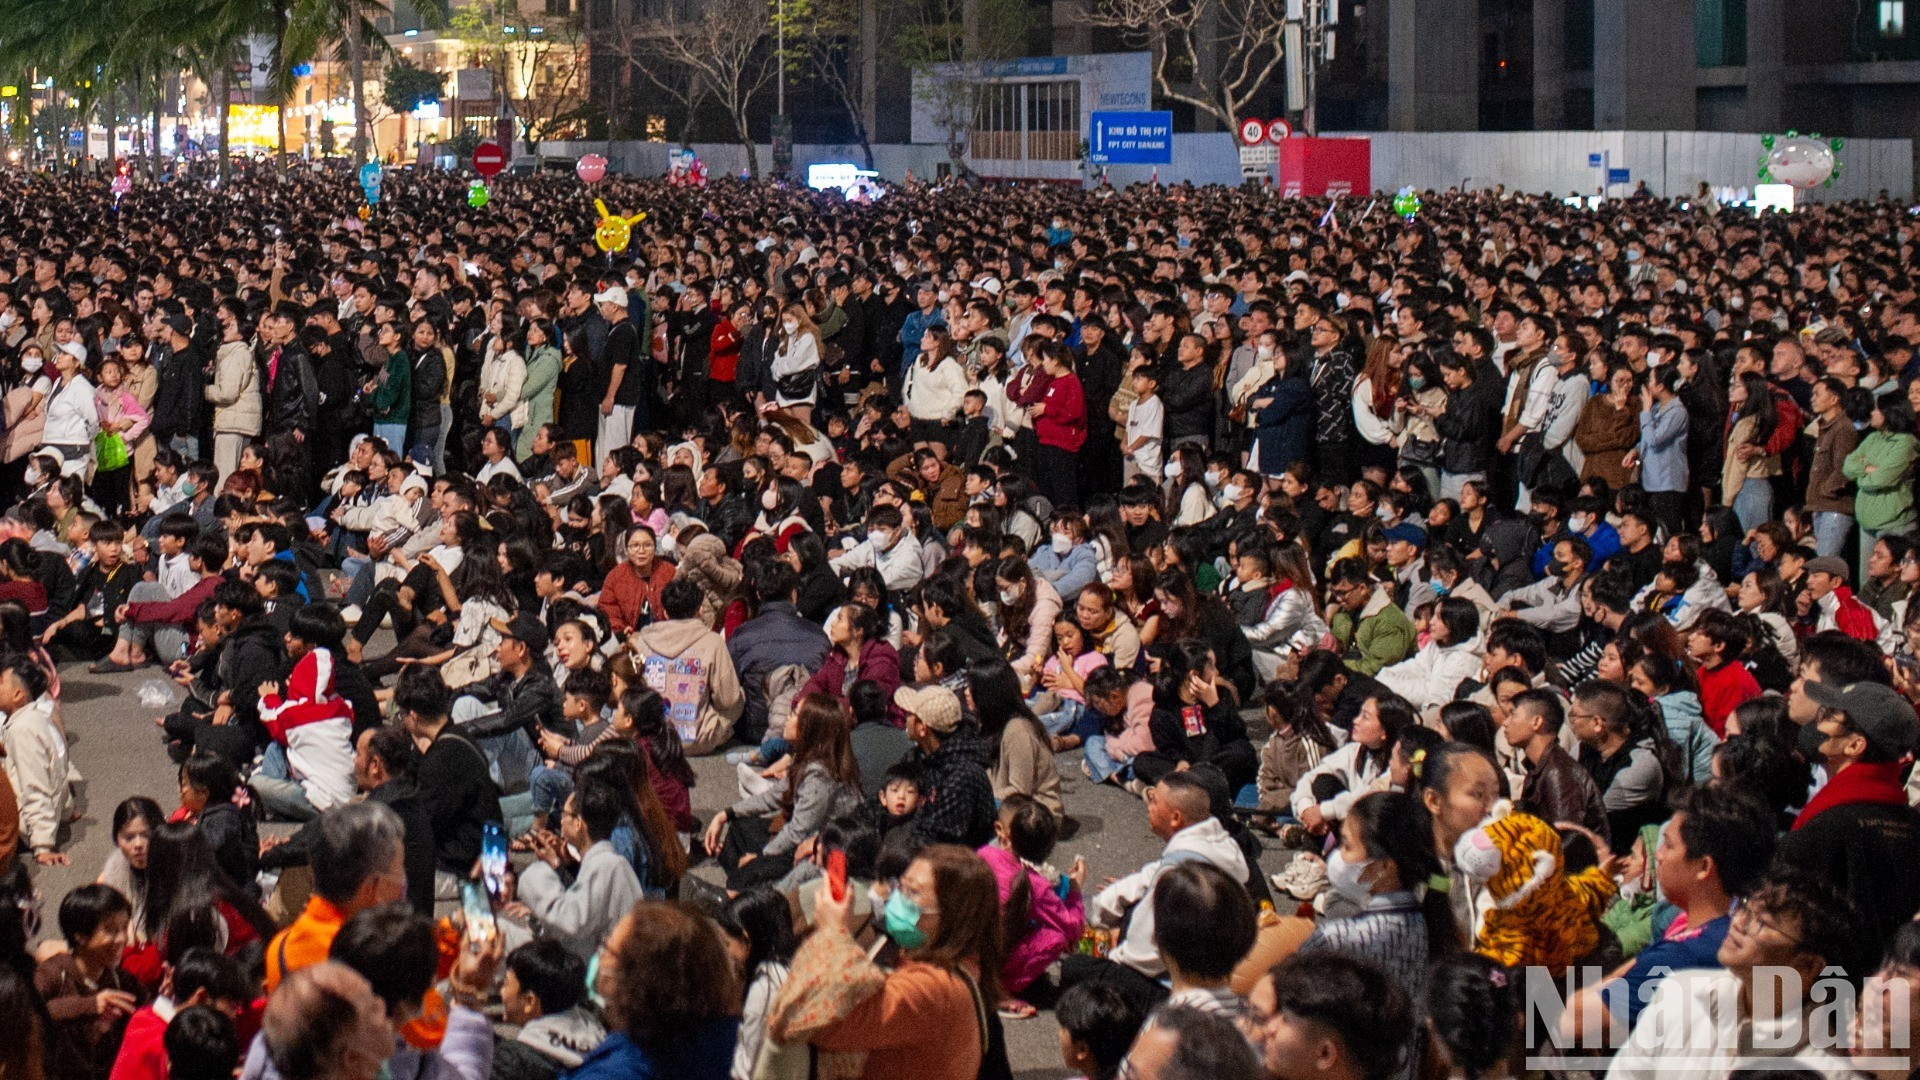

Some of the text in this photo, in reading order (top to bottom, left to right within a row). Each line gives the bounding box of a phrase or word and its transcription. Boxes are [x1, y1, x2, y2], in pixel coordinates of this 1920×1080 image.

[1100, 93, 1146, 105] NEWTECONS
[1108, 127, 1125, 136] KHU
[1153, 126, 1167, 136] FPT
[1248, 126, 1259, 138] 40
[1108, 141, 1120, 149] FPT
[1121, 141, 1136, 149] CITY
